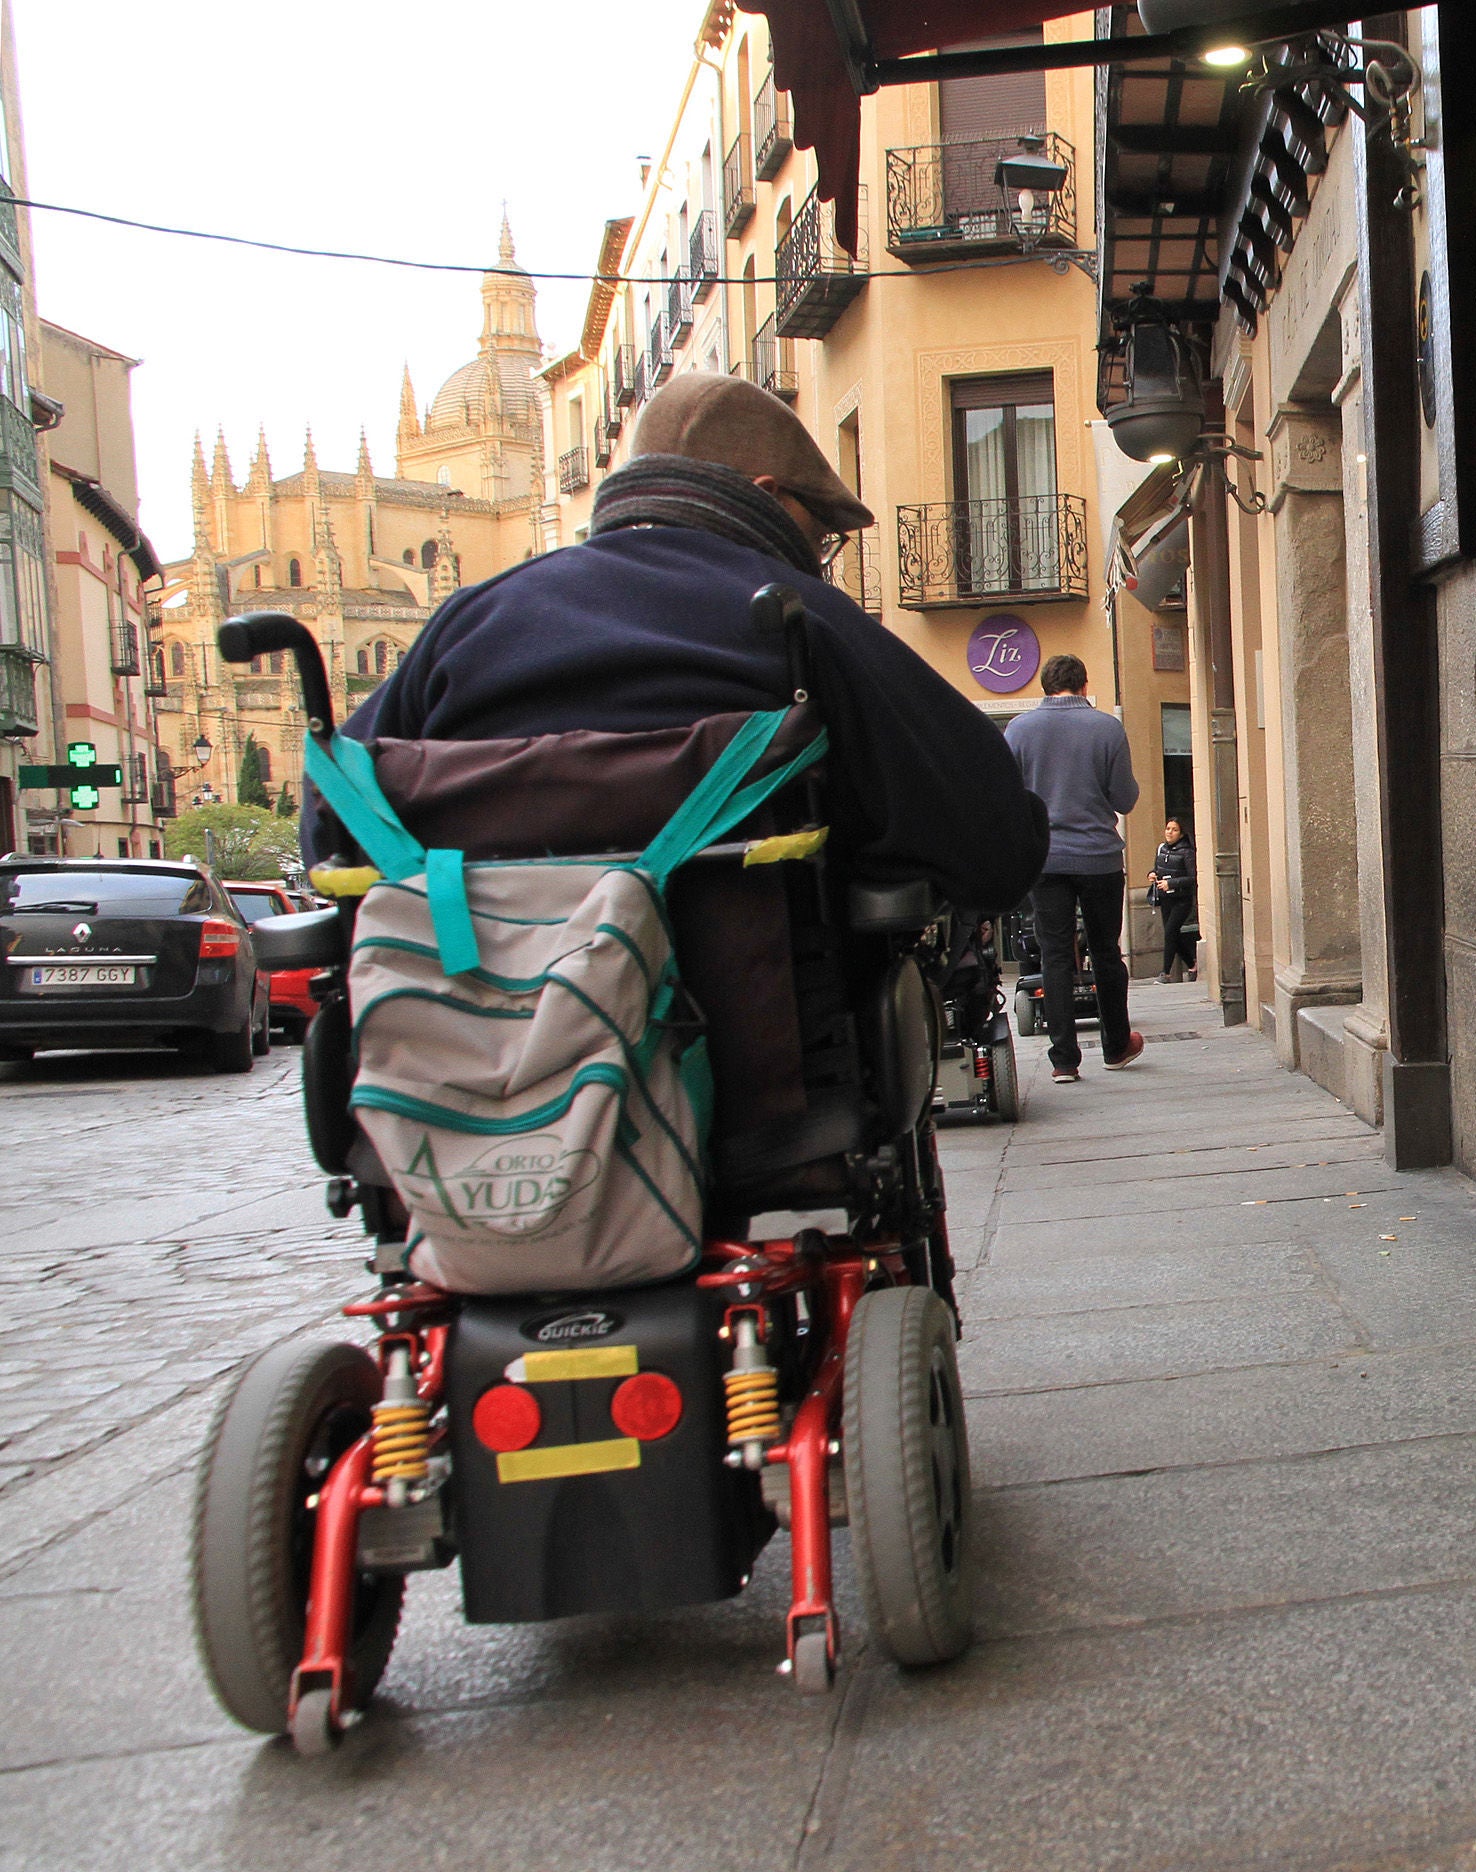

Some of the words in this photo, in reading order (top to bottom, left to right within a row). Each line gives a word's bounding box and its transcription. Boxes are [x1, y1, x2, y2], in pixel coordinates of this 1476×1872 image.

[972, 628, 1021, 677] Liz
[45, 968, 90, 982] 7387
[97, 968, 130, 982] GGY
[495, 1154, 554, 1172] ORTO
[537, 1321, 613, 1341] QUICKIE
